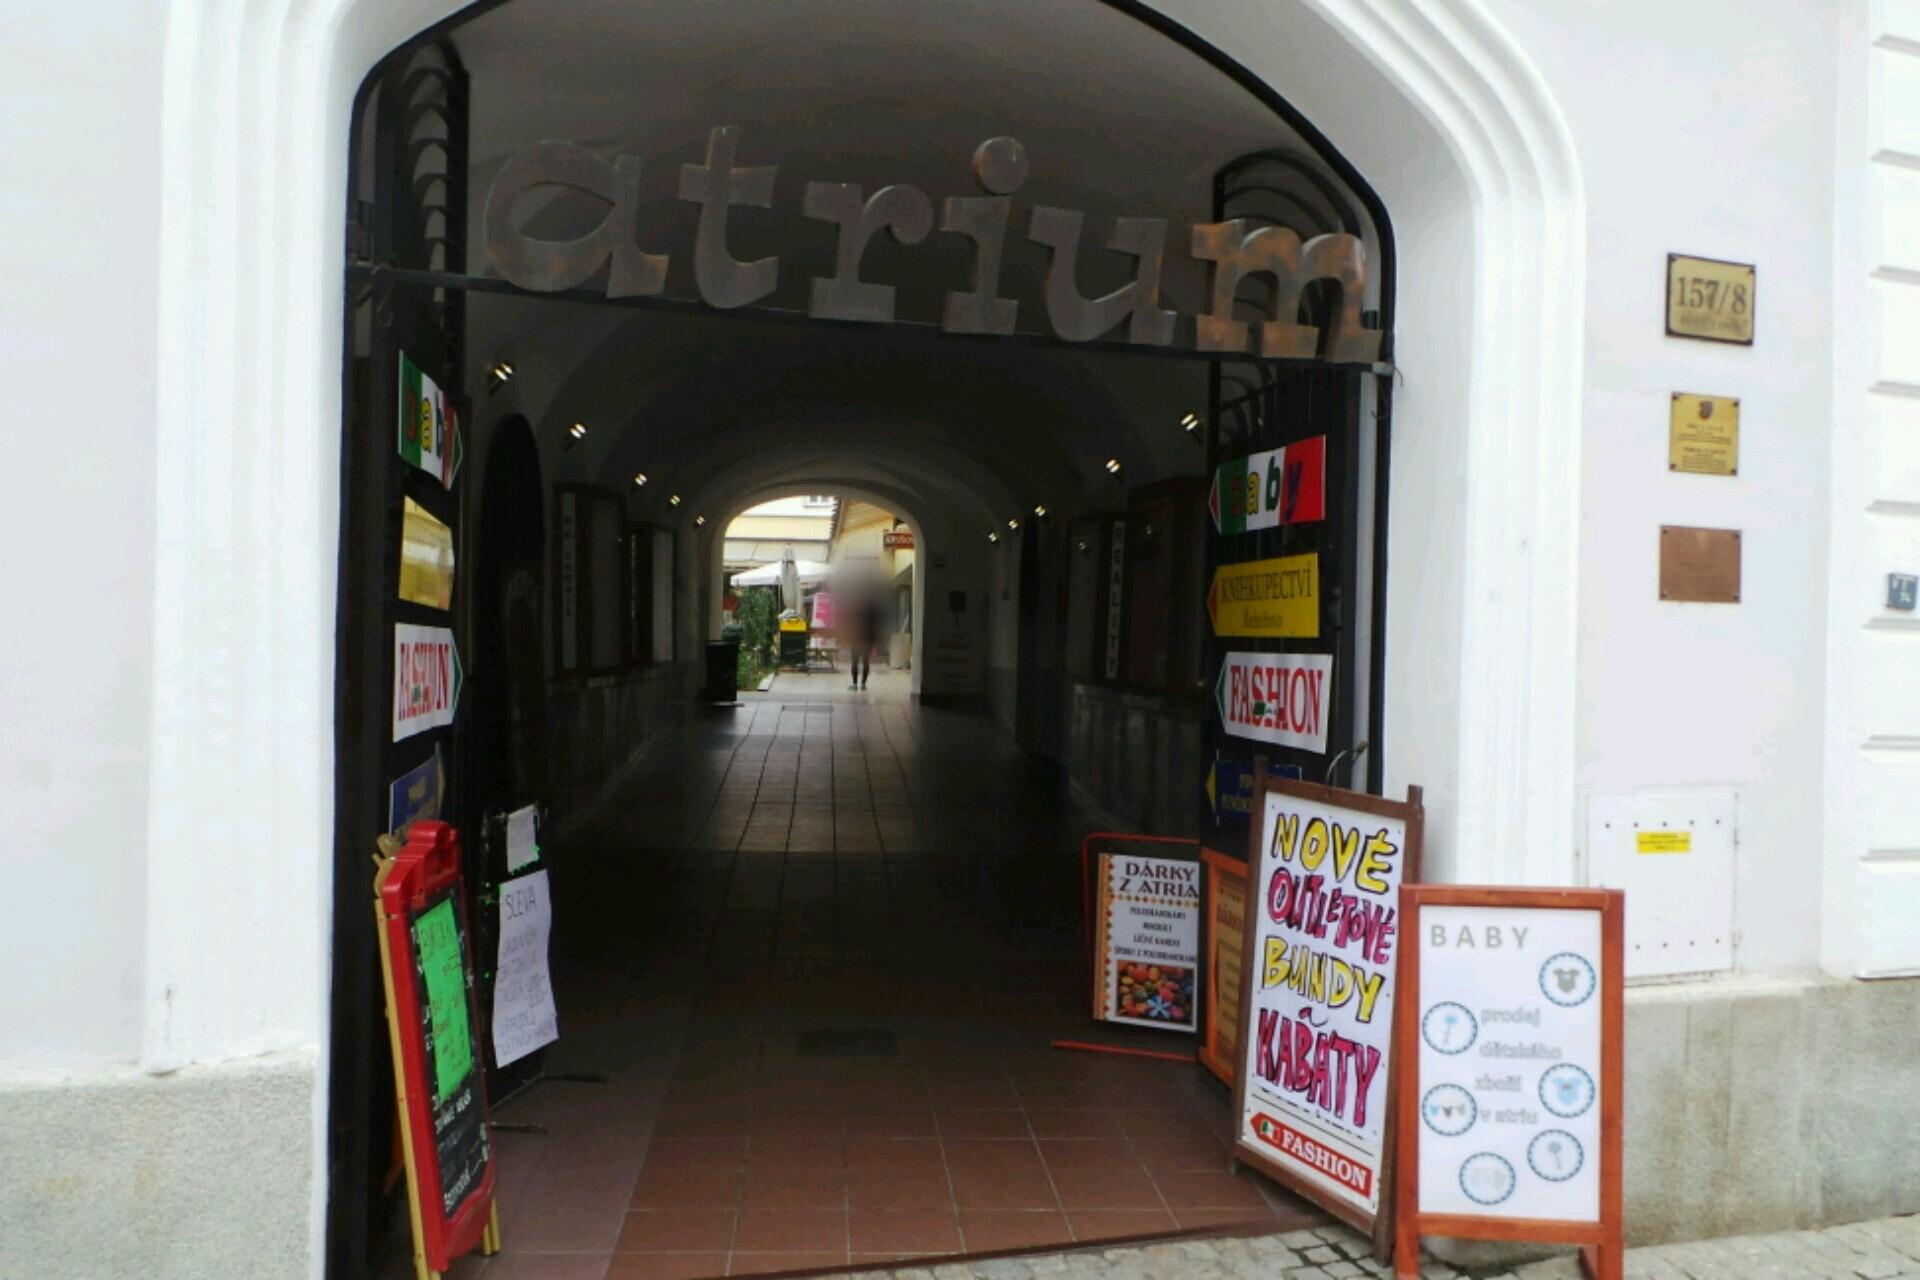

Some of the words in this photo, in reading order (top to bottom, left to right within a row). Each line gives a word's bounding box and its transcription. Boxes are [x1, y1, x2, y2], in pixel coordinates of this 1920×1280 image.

[485, 126, 1383, 363] atrium
[1677, 275, 1747, 315] 157/8
[1221, 560, 1313, 603] KNIHKUPECTVÍ
[1229, 665, 1324, 736] FASHION
[1125, 860, 1195, 882] DÁRKY
[1271, 813, 1399, 894] NOVÉ
[1119, 877, 1131, 892] Z
[1137, 879, 1198, 898] ATRIA
[1267, 867, 1396, 965] OUTLETOVÉ
[1430, 924, 1529, 949] BABY
[1262, 935, 1386, 1024] BUNDY
[1481, 1007, 1541, 1028] prodej
[1479, 1109, 1491, 1121] v
[1281, 1129, 1368, 1190] FASHION
